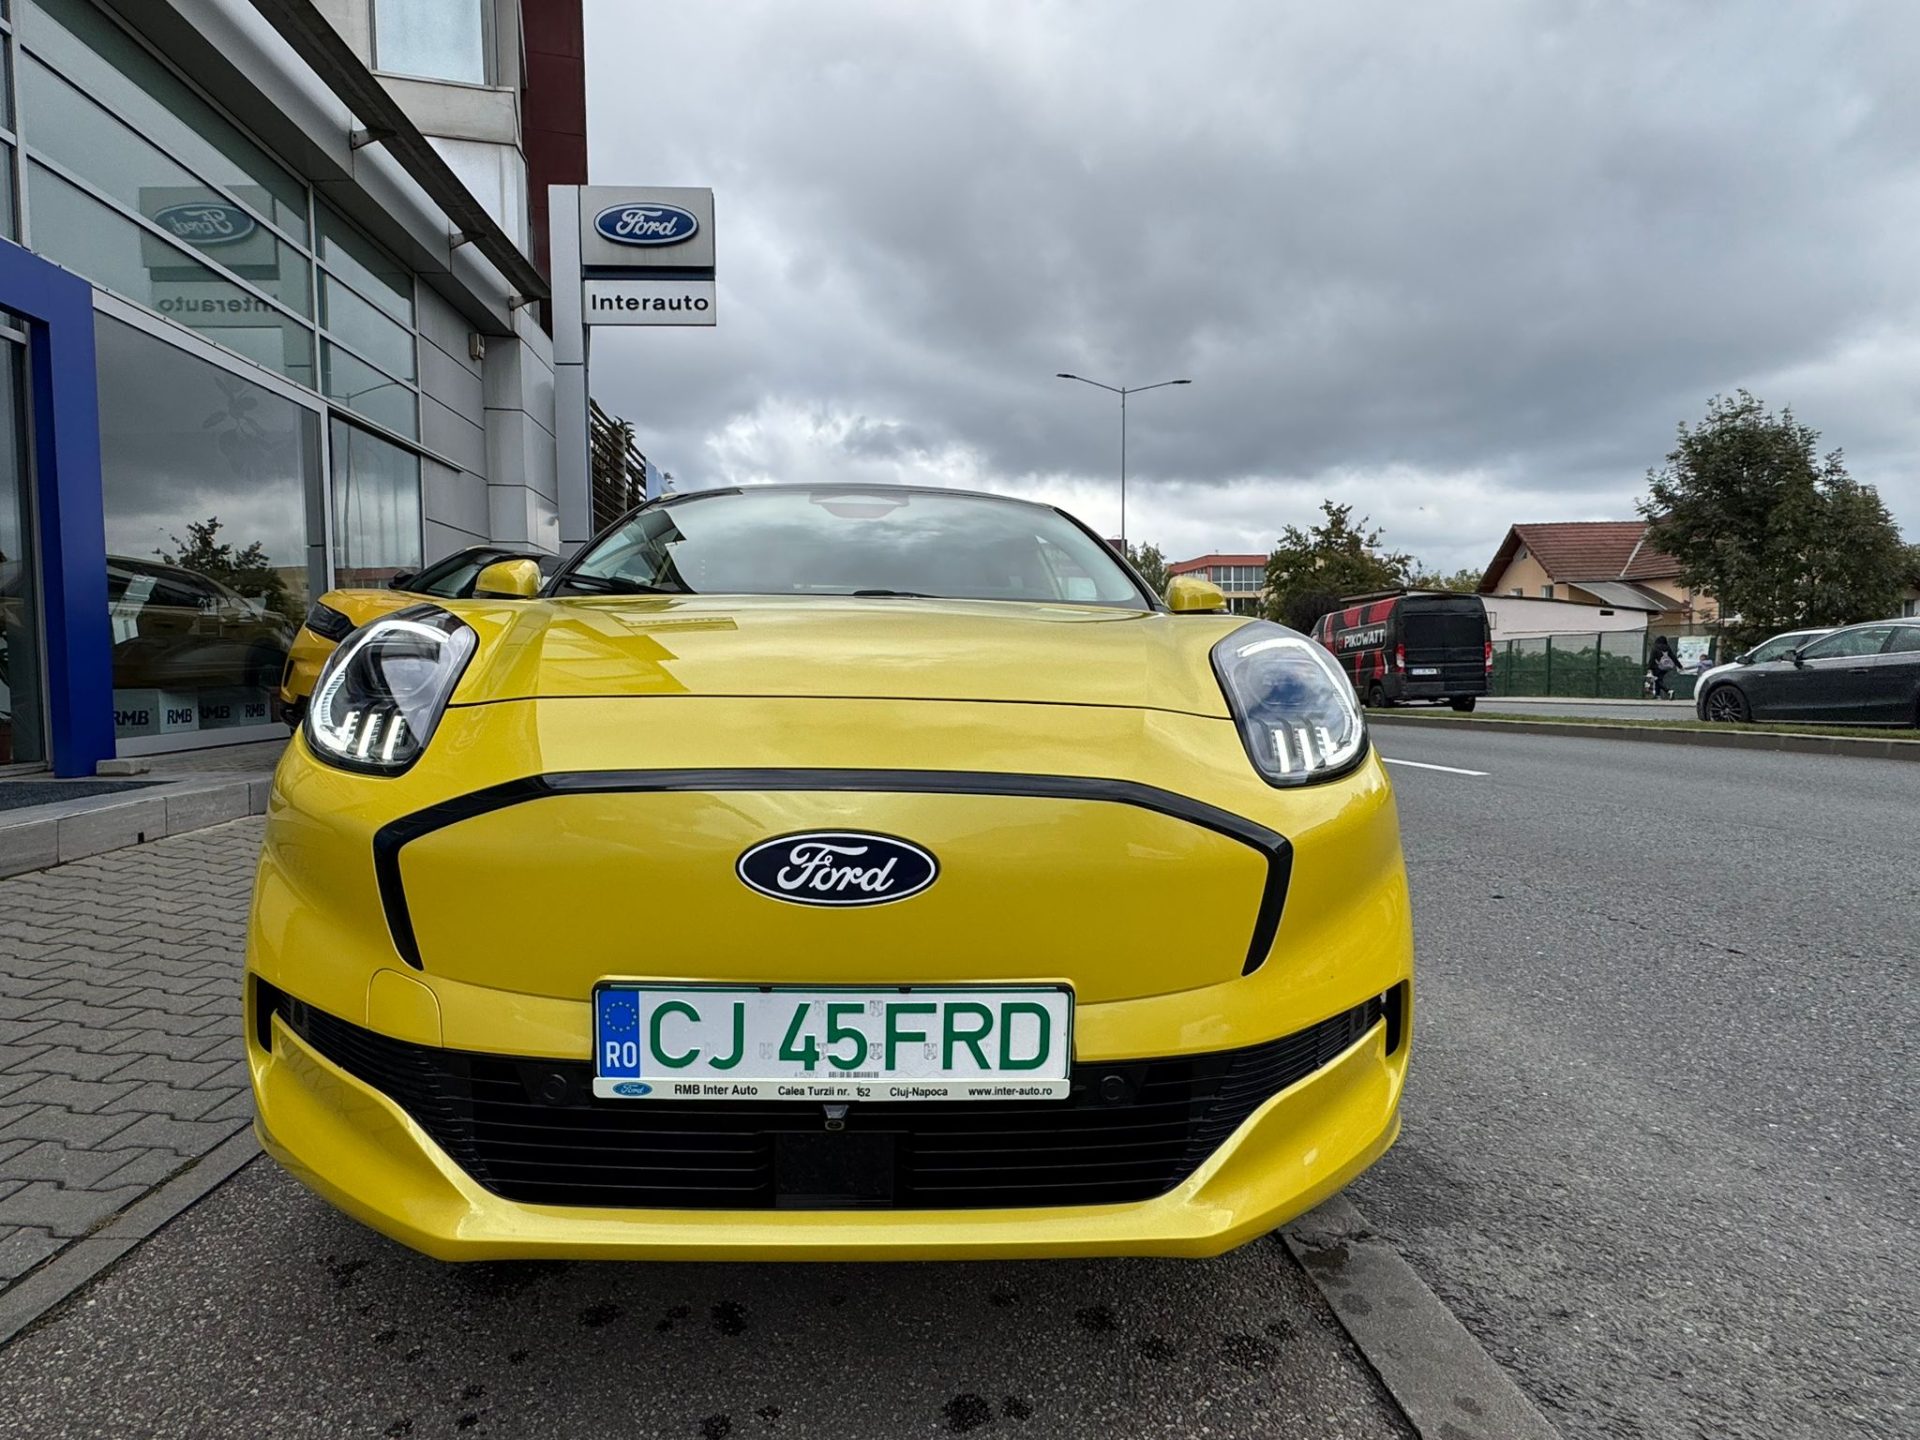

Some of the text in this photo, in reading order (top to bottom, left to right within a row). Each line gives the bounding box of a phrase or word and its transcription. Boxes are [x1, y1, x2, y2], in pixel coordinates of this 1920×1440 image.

[615, 208, 678, 236] Ford
[591, 294, 709, 311] Interauto
[1344, 629, 1385, 649] PIKOWATT
[167, 708, 192, 725] RMB
[245, 703, 266, 718] RMB
[777, 842, 898, 892] Ford
[650, 1001, 745, 1070] CJ
[606, 1041, 638, 1068] RO
[620, 1083, 645, 1094] Ford
[674, 1084, 701, 1095] RMB
[703, 1084, 729, 1096] Inter
[732, 1084, 758, 1096] Auto
[777, 1085, 806, 1096] Calea
[807, 1085, 835, 1097] Turzii
[837, 1087, 850, 1096] nr.
[889, 1086, 948, 1098] Cluj-Napoca
[968, 1086, 1053, 1097] www.inter-auto.ro
